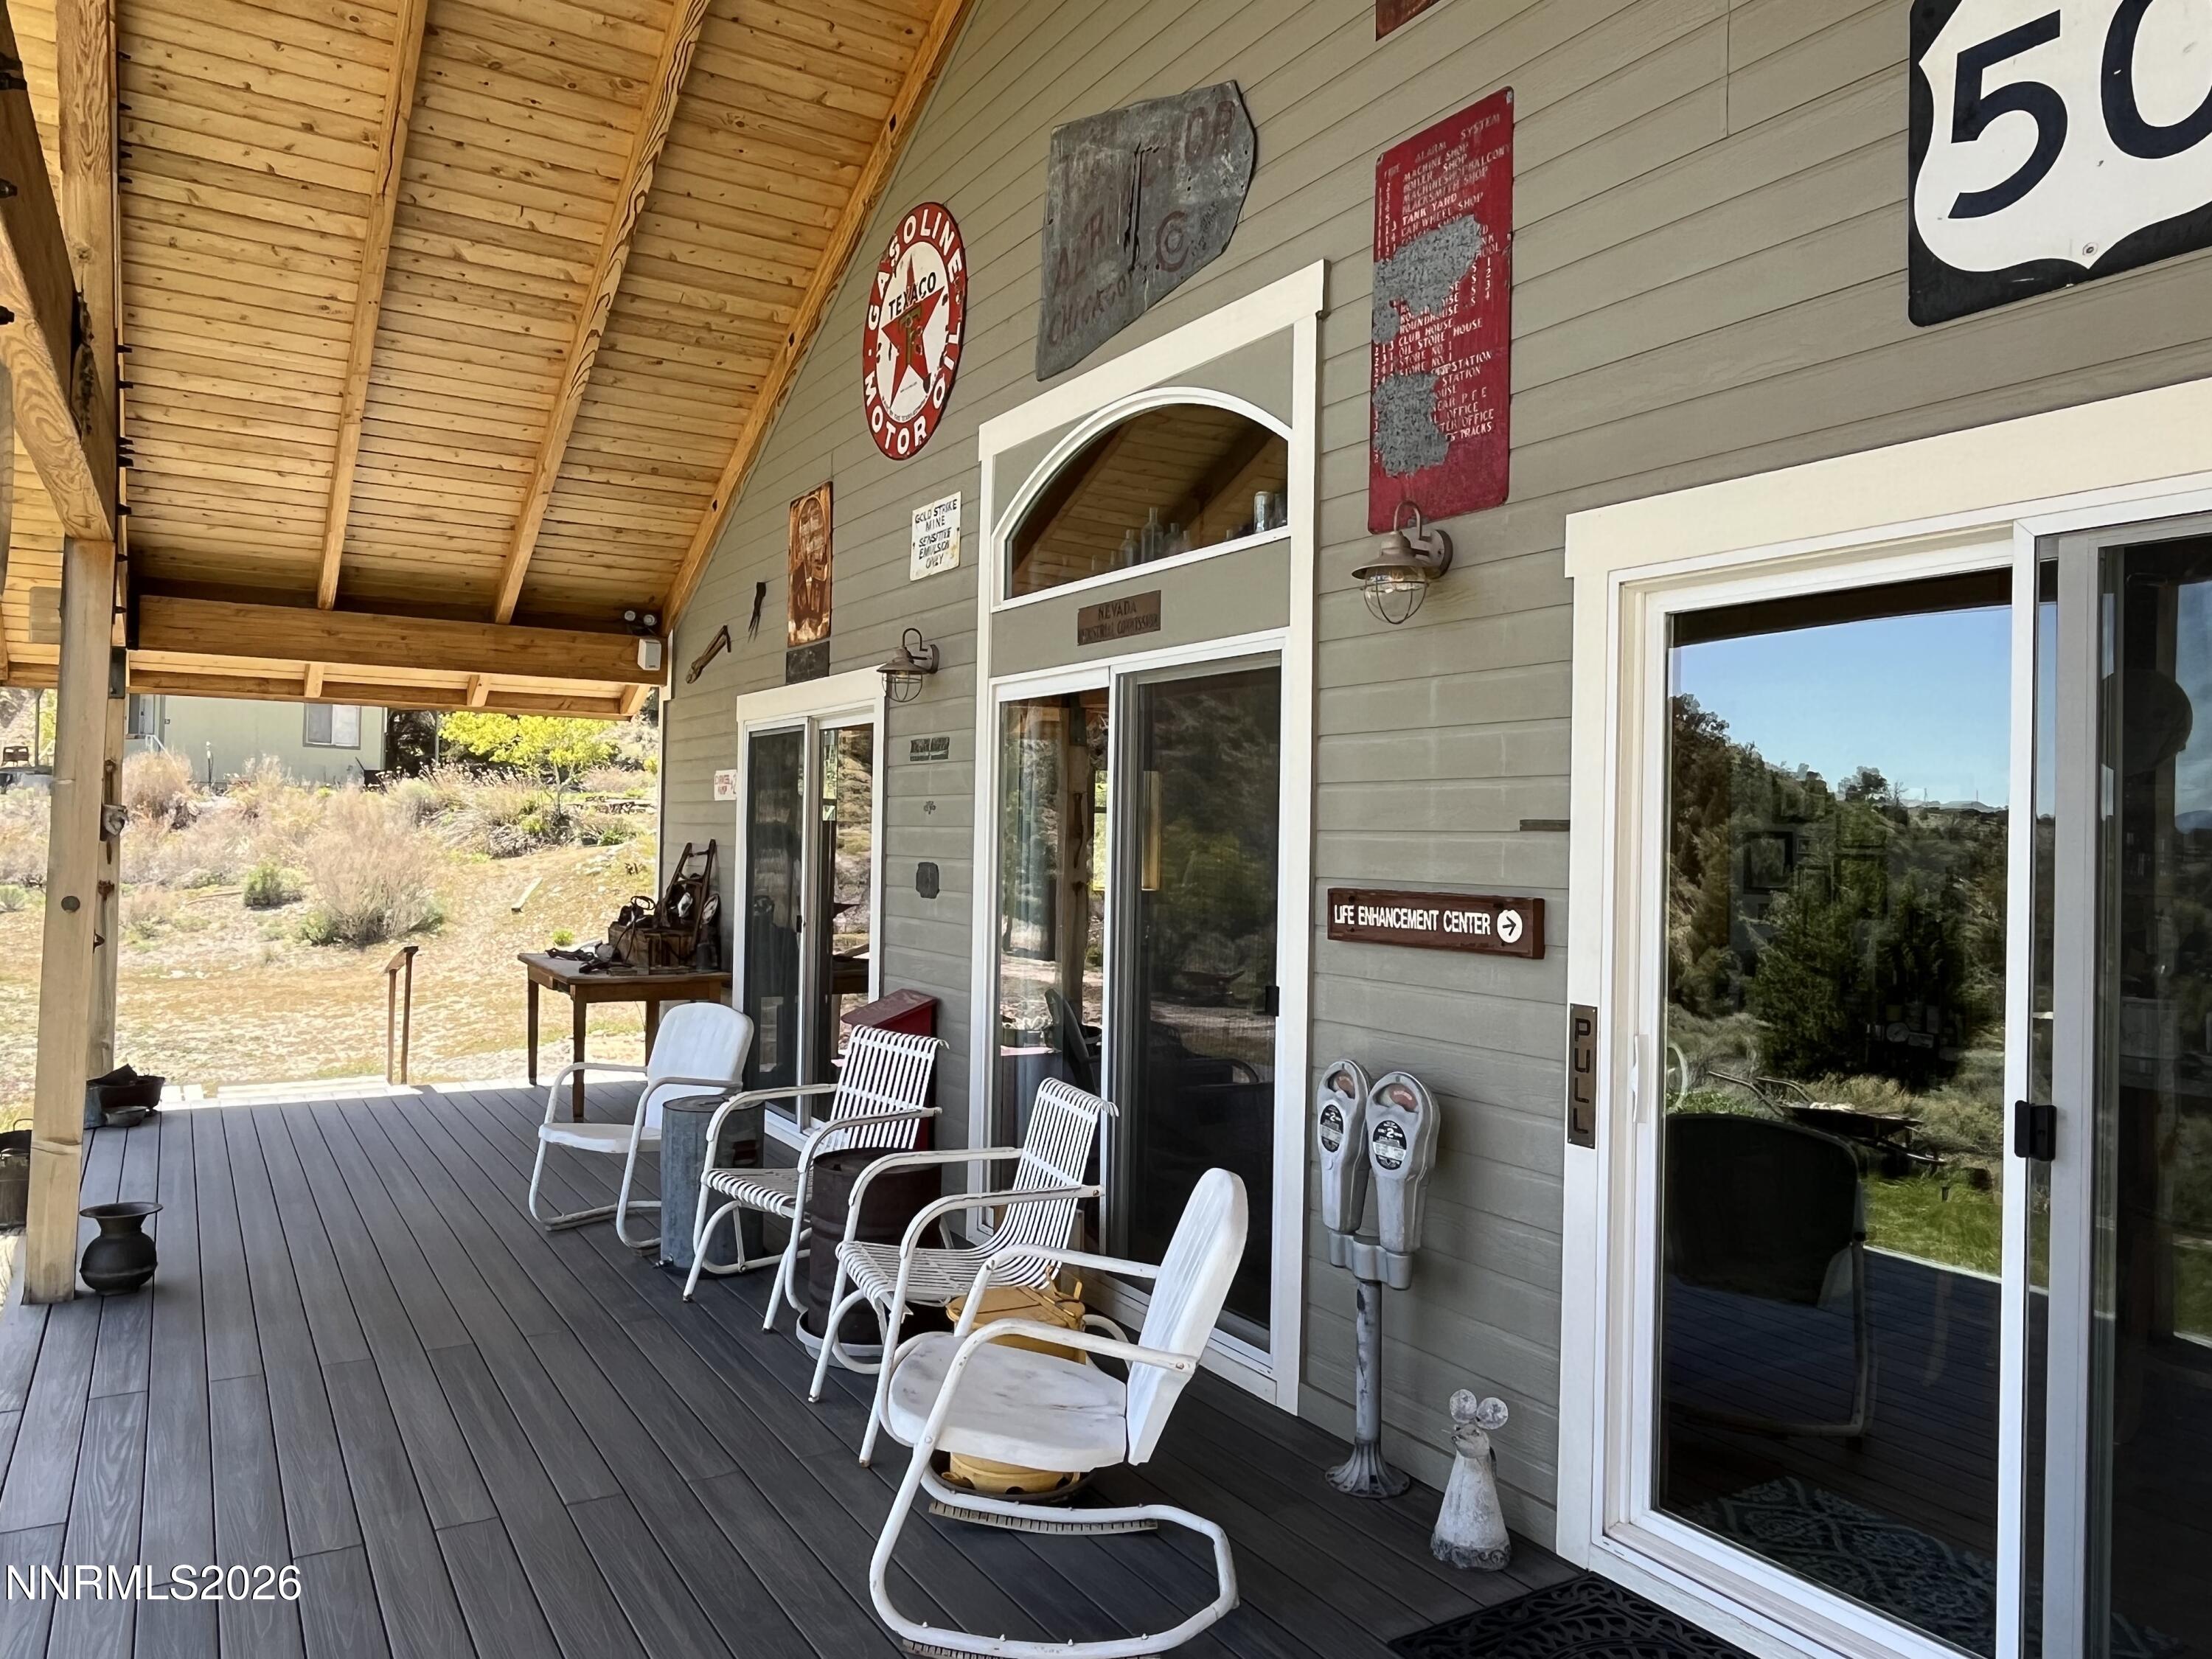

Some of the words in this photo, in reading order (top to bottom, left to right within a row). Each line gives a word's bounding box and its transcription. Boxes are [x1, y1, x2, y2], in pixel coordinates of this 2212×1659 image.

[1948, 0, 2212, 220] 50
[1461, 113, 1500, 140] SYSTEM
[1402, 156, 1442, 183] MACHINE
[1444, 142, 1469, 161] SHOP
[1443, 153, 1467, 173] SHOP
[1464, 166, 1489, 186] SHOP
[1402, 208, 1427, 226] TANK
[1432, 192, 1458, 212] YARD
[1422, 206, 1453, 228] WHEEL
[1458, 192, 1484, 211] SHOP
[867, 207, 963, 331] GASOLINE
[888, 271, 938, 322] TEXACO
[1398, 331, 1420, 347] CLUB
[1425, 319, 1453, 337] HOUSE
[1399, 344, 1412, 358] OIL
[1417, 332, 1445, 350] STORE
[1453, 317, 1483, 337] HOUSE
[932, 321, 961, 410] OIL
[1399, 350, 1426, 366] STORE
[1451, 350, 1493, 372] STATION
[1442, 364, 1481, 387] STATION
[1481, 386, 1487, 398] E
[865, 369, 928, 456] MOTOR
[1447, 400, 1478, 421] OFFICE
[1461, 408, 1495, 428] OFFICE
[1460, 420, 1494, 440] TRACKS
[914, 509, 932, 524] GOLD
[925, 515, 945, 532] MINE
[1097, 600, 1137, 621] NEVADA
[1334, 905, 1355, 925] LIFE
[1358, 906, 1439, 931] ENHANCEMENT
[1443, 910, 1492, 936] CENTER
[1572, 1017, 1592, 1135] PULL
